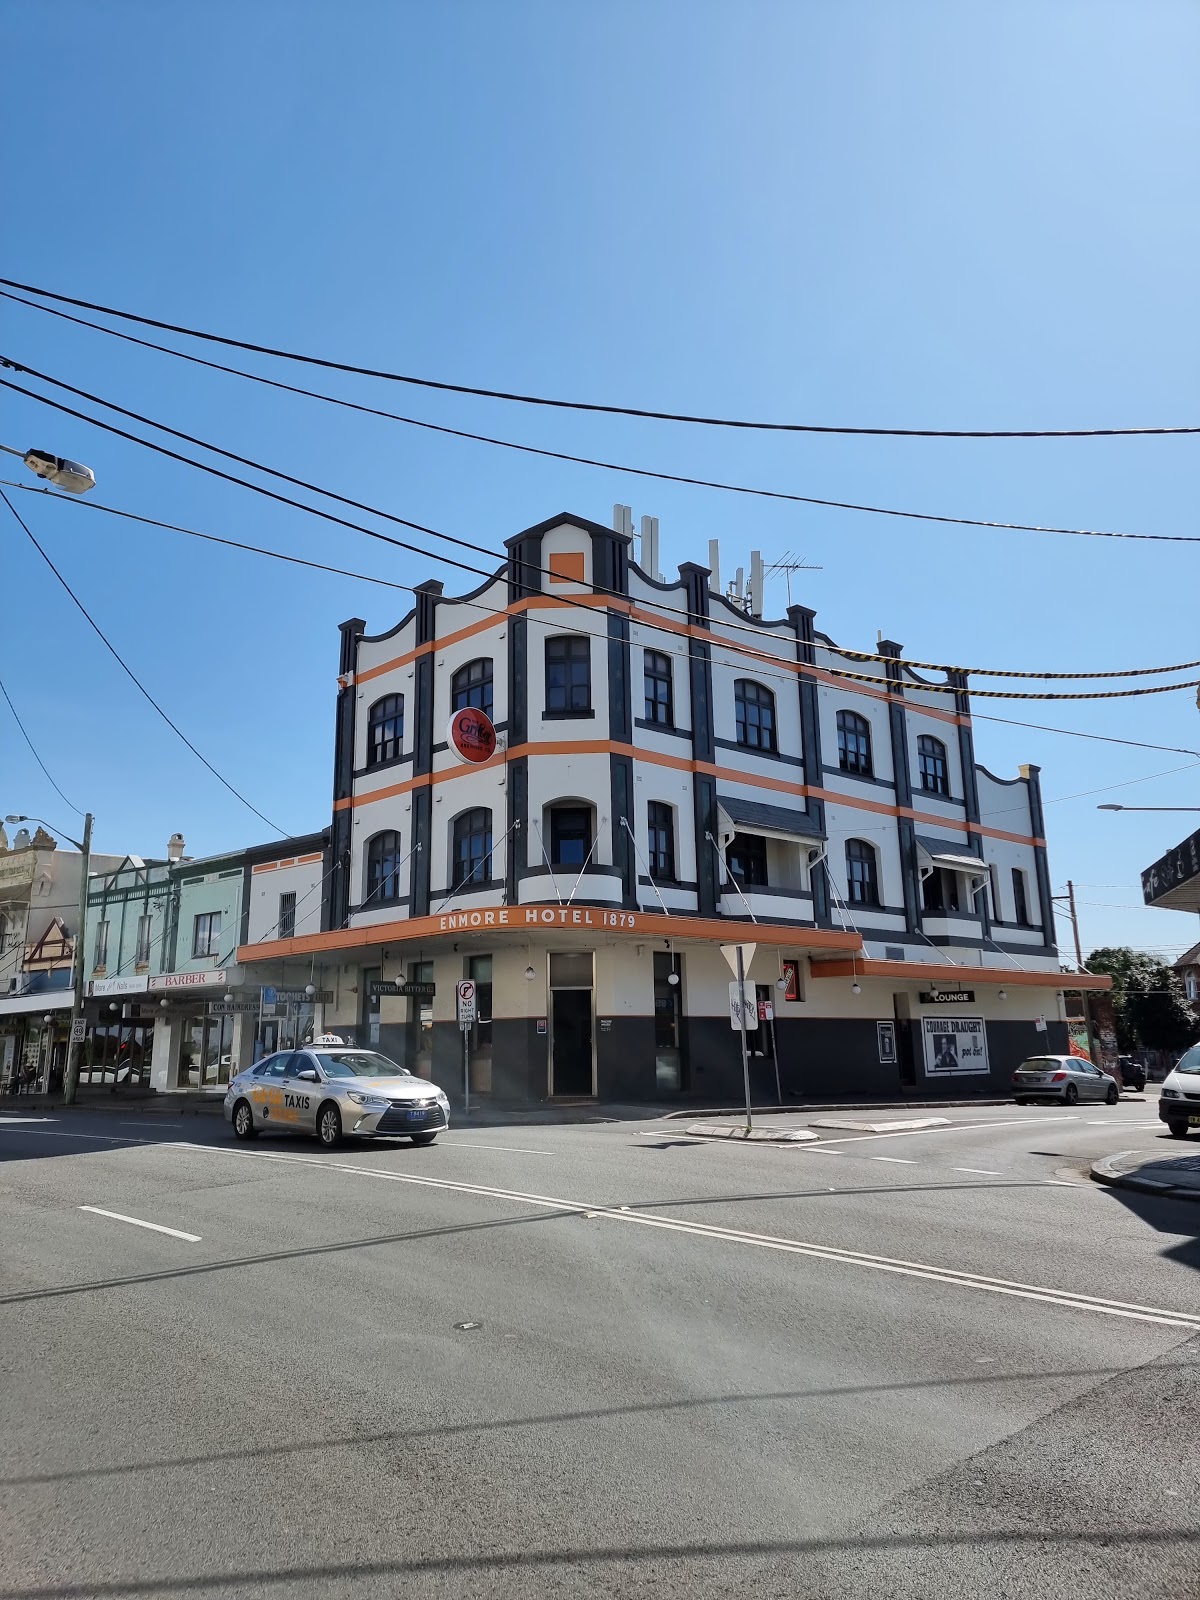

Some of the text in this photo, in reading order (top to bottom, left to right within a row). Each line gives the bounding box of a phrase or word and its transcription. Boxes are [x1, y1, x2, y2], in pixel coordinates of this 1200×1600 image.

[440, 909, 636, 930] ENMORE HOTEL 1879
[165, 973, 206, 987] BARBER
[372, 984, 404, 993] VICTORIA
[404, 984, 426, 993] BITTER
[934, 993, 969, 1002] LOUNGE
[951, 1020, 981, 1033] DRAUGHT
[284, 1094, 310, 1110] TAXIS
